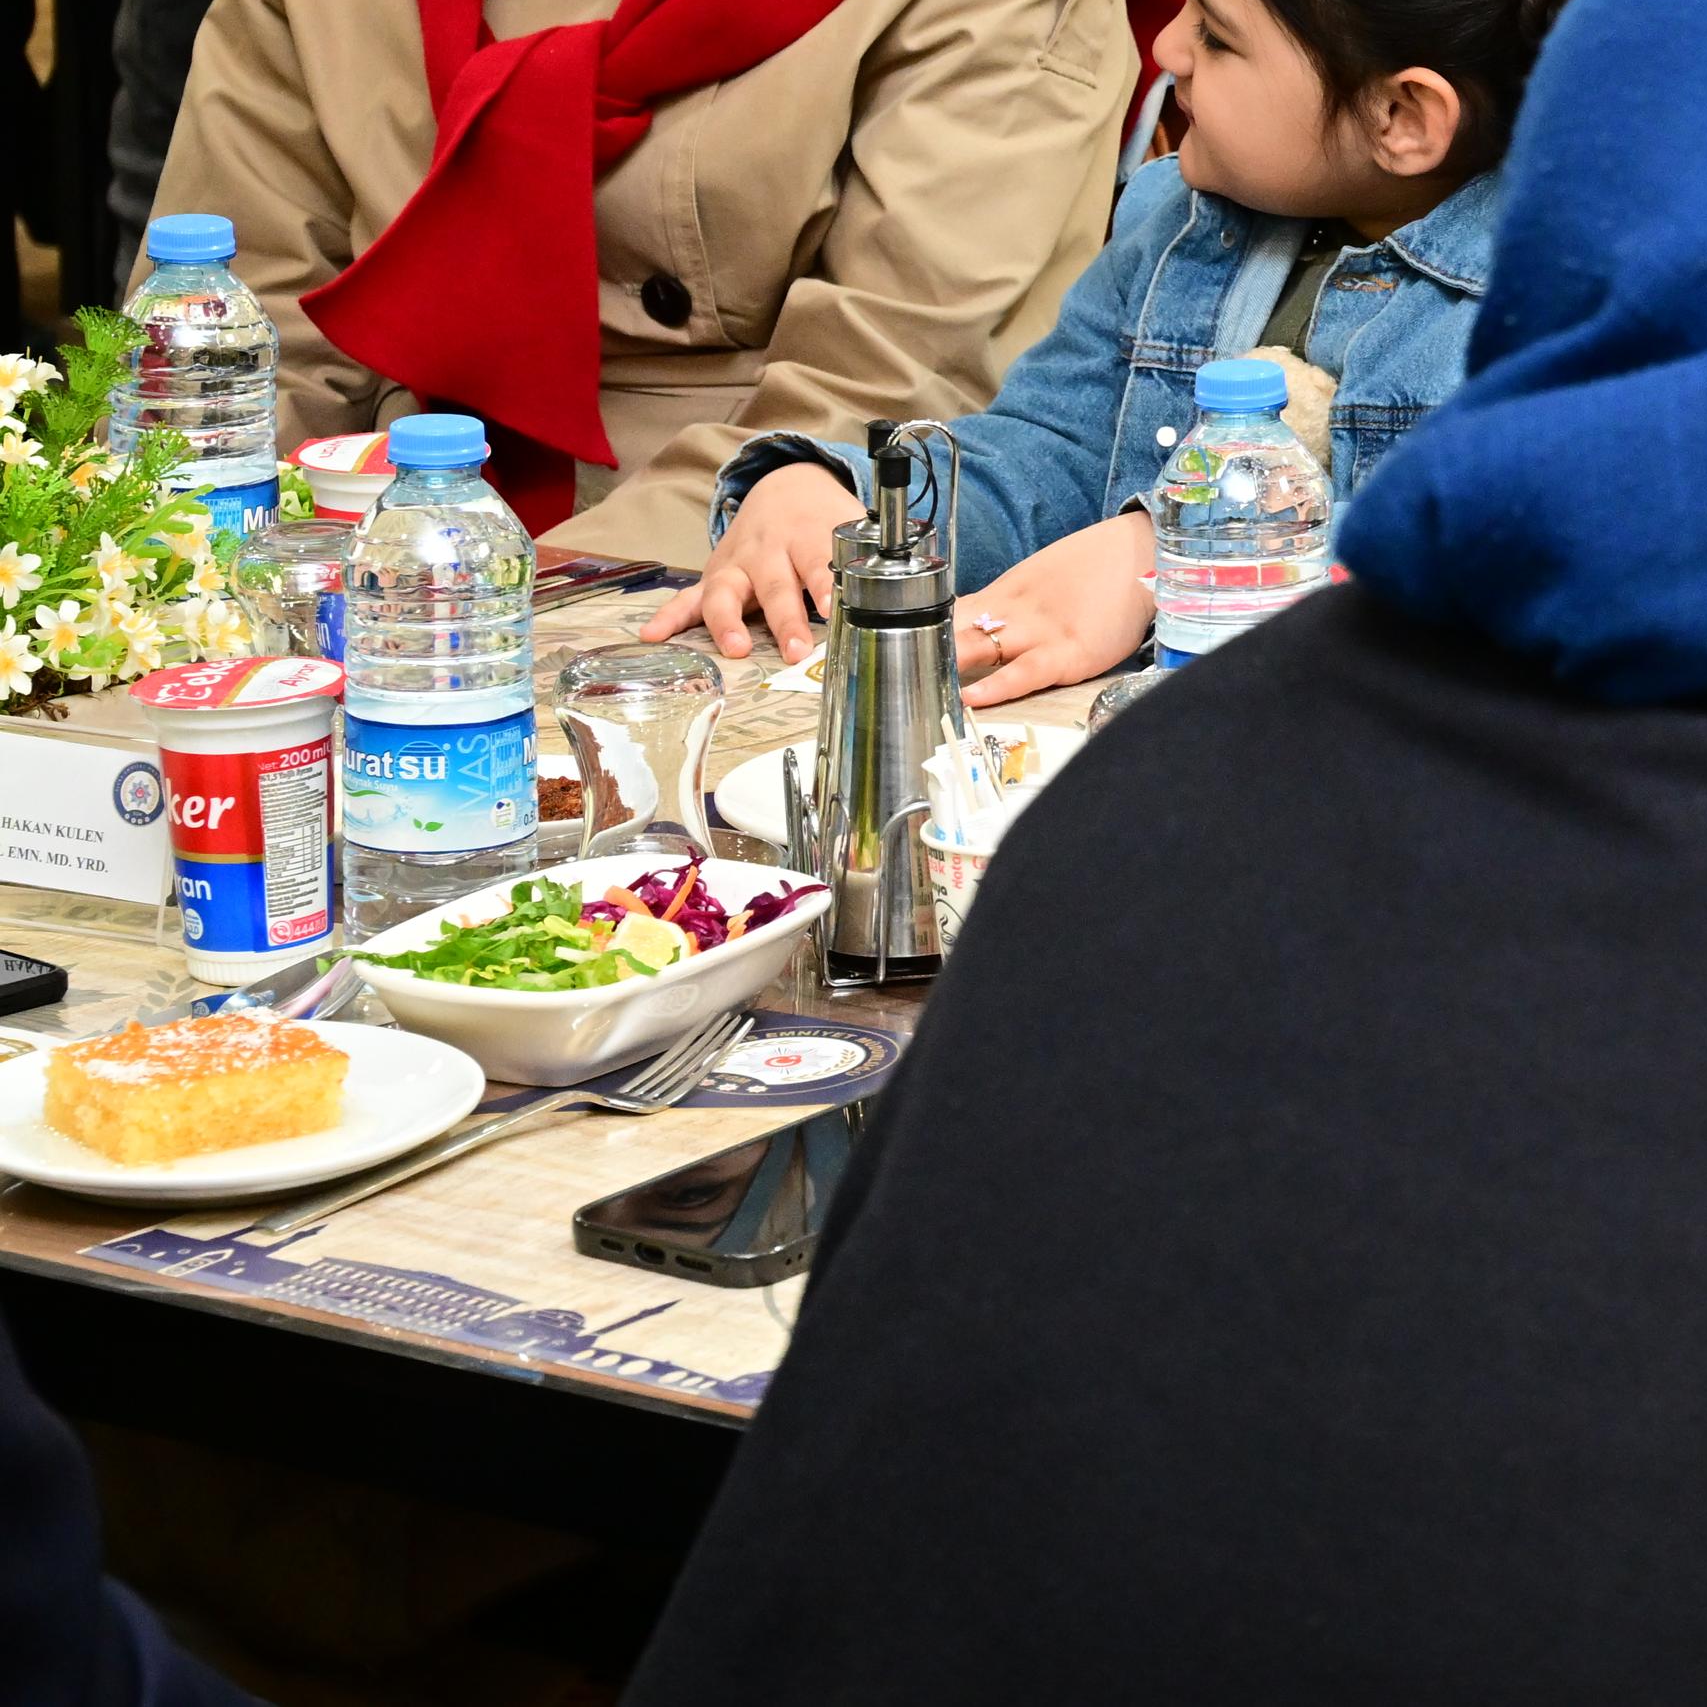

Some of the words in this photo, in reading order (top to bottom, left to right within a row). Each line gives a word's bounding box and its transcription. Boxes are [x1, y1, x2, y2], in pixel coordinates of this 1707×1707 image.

[279, 749, 311, 769] 200
[343, 738, 394, 779] urat
[399, 755, 445, 781] su
[166, 778, 236, 829] ker
[1, 817, 51, 835] HAKAN
[56, 825, 104, 843] KULEN
[8, 846, 42, 863] EMN.
[46, 852, 72, 867] MD.
[76, 856, 109, 873] YRD.
